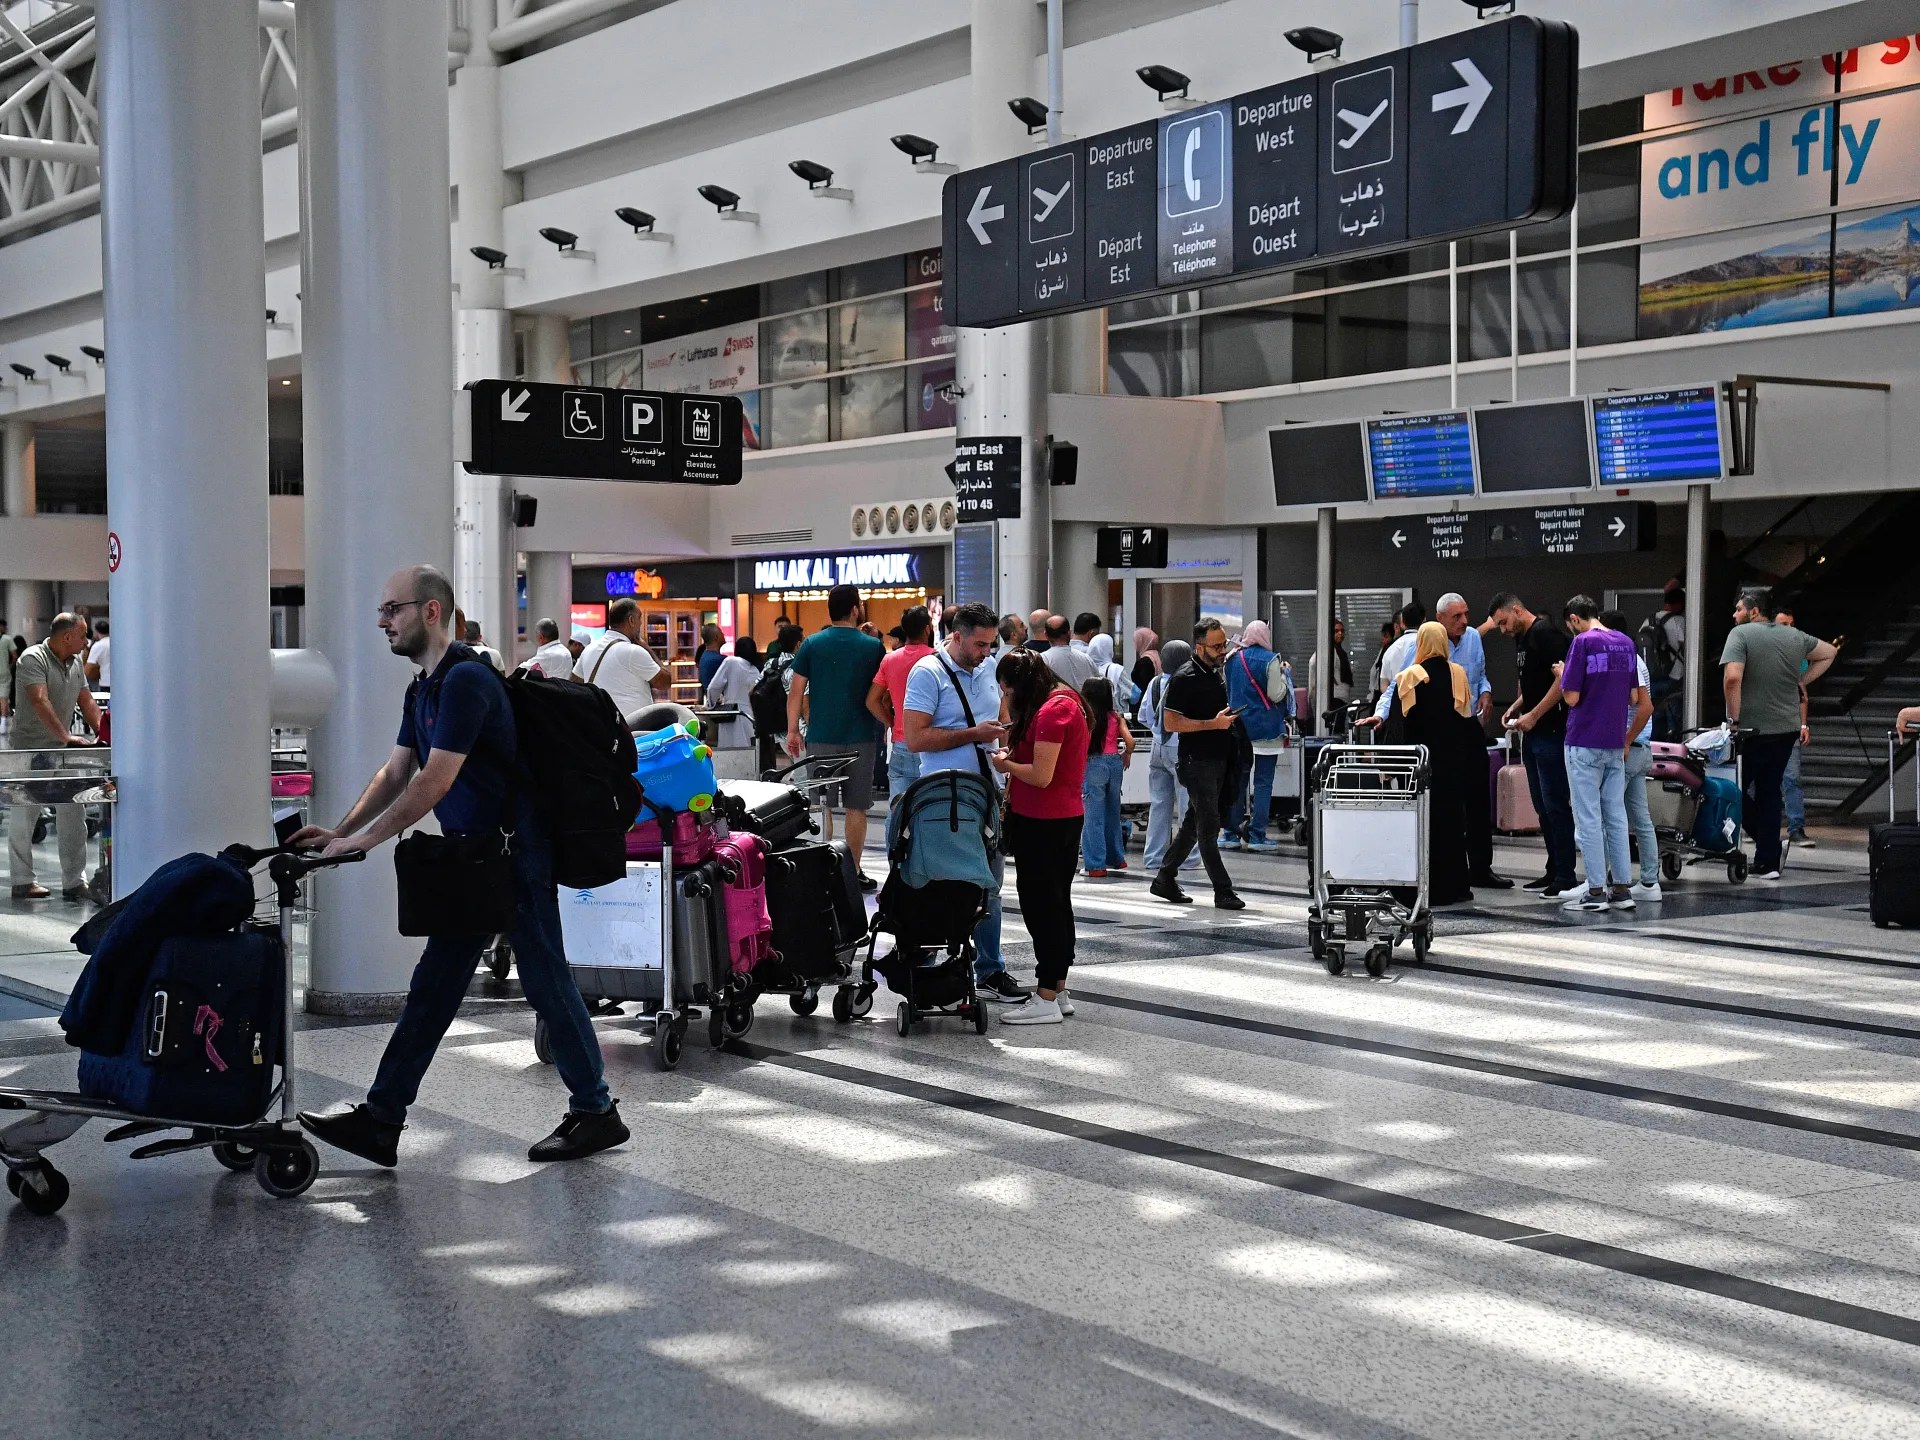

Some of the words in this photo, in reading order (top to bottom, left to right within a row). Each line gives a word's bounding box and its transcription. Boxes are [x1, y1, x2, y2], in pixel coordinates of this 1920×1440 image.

[1880, 34, 1920, 64] s
[1238, 93, 1312, 127] Departure
[1256, 128, 1294, 152] West
[1089, 136, 1152, 166] Departure
[1658, 118, 1770, 200] and
[1792, 106, 1881, 186] fly
[1106, 166, 1134, 190] East
[1340, 178, 1384, 204] ذهاب
[1250, 196, 1300, 228] Départ
[1338, 204, 1385, 236] (غرب)
[1182, 222, 1204, 236] هاتف
[1098, 231, 1142, 258] Départ
[1173, 238, 1216, 256] Telephone
[1252, 230, 1297, 256] Ouest
[920, 253, 943, 276] Goi
[1036, 248, 1068, 268] ذهاب
[1173, 255, 1216, 274] Téléphone
[1110, 266, 1130, 284] Est
[1034, 274, 1068, 299] (شرق)
[732, 336, 754, 351] SWISS
[688, 347, 718, 362] Lufthansa
[710, 376, 738, 390] Eurowings
[1608, 396, 1636, 405] Departures
[632, 402, 654, 434] P
[621, 447, 644, 456] سيارات
[645, 448, 666, 456] مواقف
[980, 444, 1004, 454] East
[632, 456, 656, 466] Parking
[686, 460, 716, 468] Elevators
[976, 460, 994, 471] Est
[683, 470, 719, 480] Ascenseurs
[970, 477, 992, 492] ذهاب
[962, 500, 966, 510] 1
[966, 499, 978, 510] TO
[980, 498, 993, 510] 45
[1426, 515, 1454, 524] Departure
[1456, 514, 1468, 522] East
[1535, 509, 1568, 520] Departure
[1568, 508, 1584, 516] West
[1432, 526, 1452, 536] Départ
[1453, 526, 1462, 534] Est
[1540, 521, 1561, 530] Départ
[1562, 519, 1581, 528] Ouest
[1437, 550, 1440, 558] 1
[1442, 550, 1450, 558] TO
[1451, 549, 1459, 558] 45
[1556, 544, 1564, 552] TO
[755, 559, 811, 590] MALAK
[811, 558, 834, 586] AL
[836, 553, 910, 585] TAWOUK
